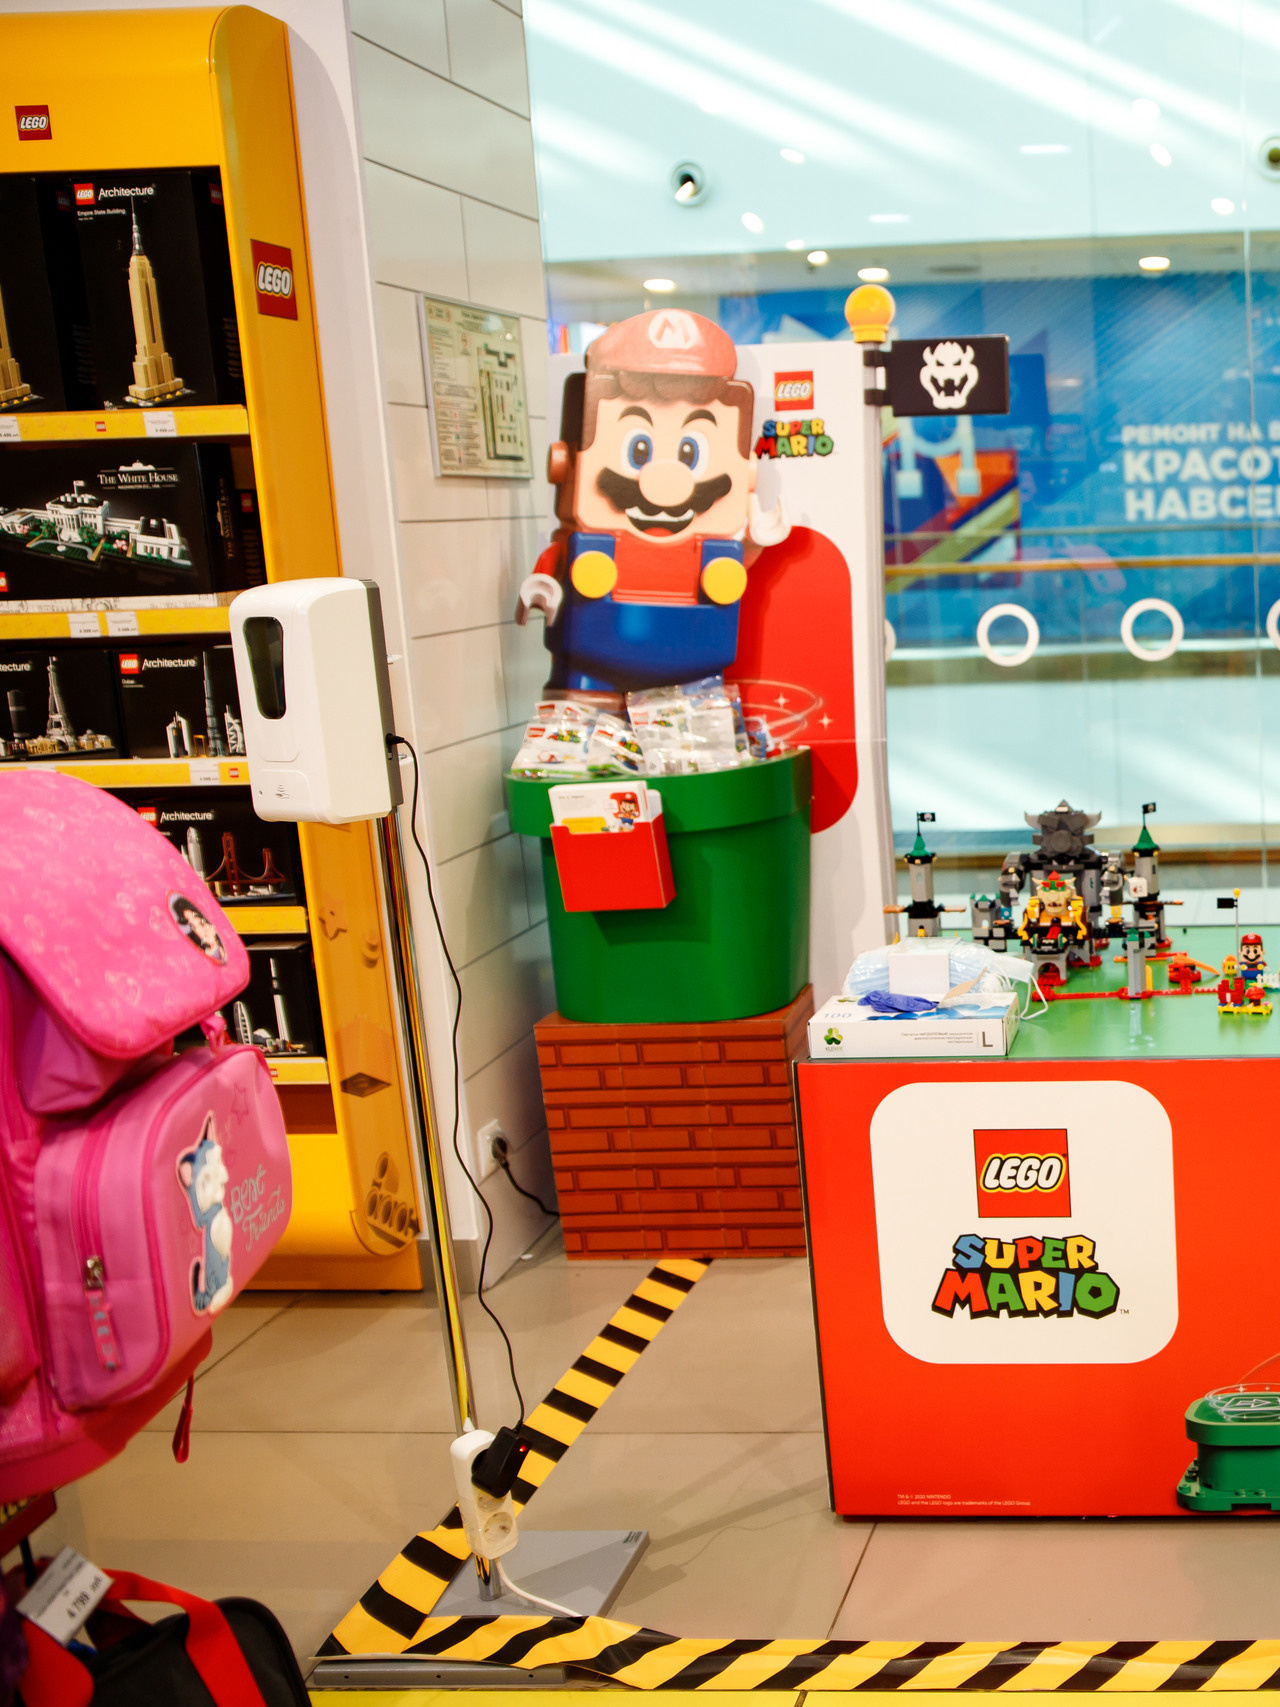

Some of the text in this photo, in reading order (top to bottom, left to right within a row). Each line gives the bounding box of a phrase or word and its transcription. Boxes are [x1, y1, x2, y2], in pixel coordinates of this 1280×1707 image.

[18, 113, 49, 131] LEGO
[76, 186, 154, 200] LEGO Architecture
[77, 209, 94, 217] Empire
[106, 207, 126, 215] Building
[256, 262, 293, 298] LEGO
[775, 379, 813, 400] LEGO
[762, 419, 825, 438] SUPER
[1121, 423, 1222, 445] РЕМОНТ
[1227, 421, 1263, 442] НА
[754, 434, 834, 459] MARIO
[97, 472, 179, 484] THE WHITE HOUSE
[142, 657, 197, 671] Architecture
[160, 810, 215, 823] Architecture
[982, 1031, 993, 1048] L
[981, 1153, 1066, 1192] LEGO
[230, 1164, 266, 1225] Best
[953, 1233, 1099, 1271] SUPER
[932, 1267, 1121, 1319] MARIO
